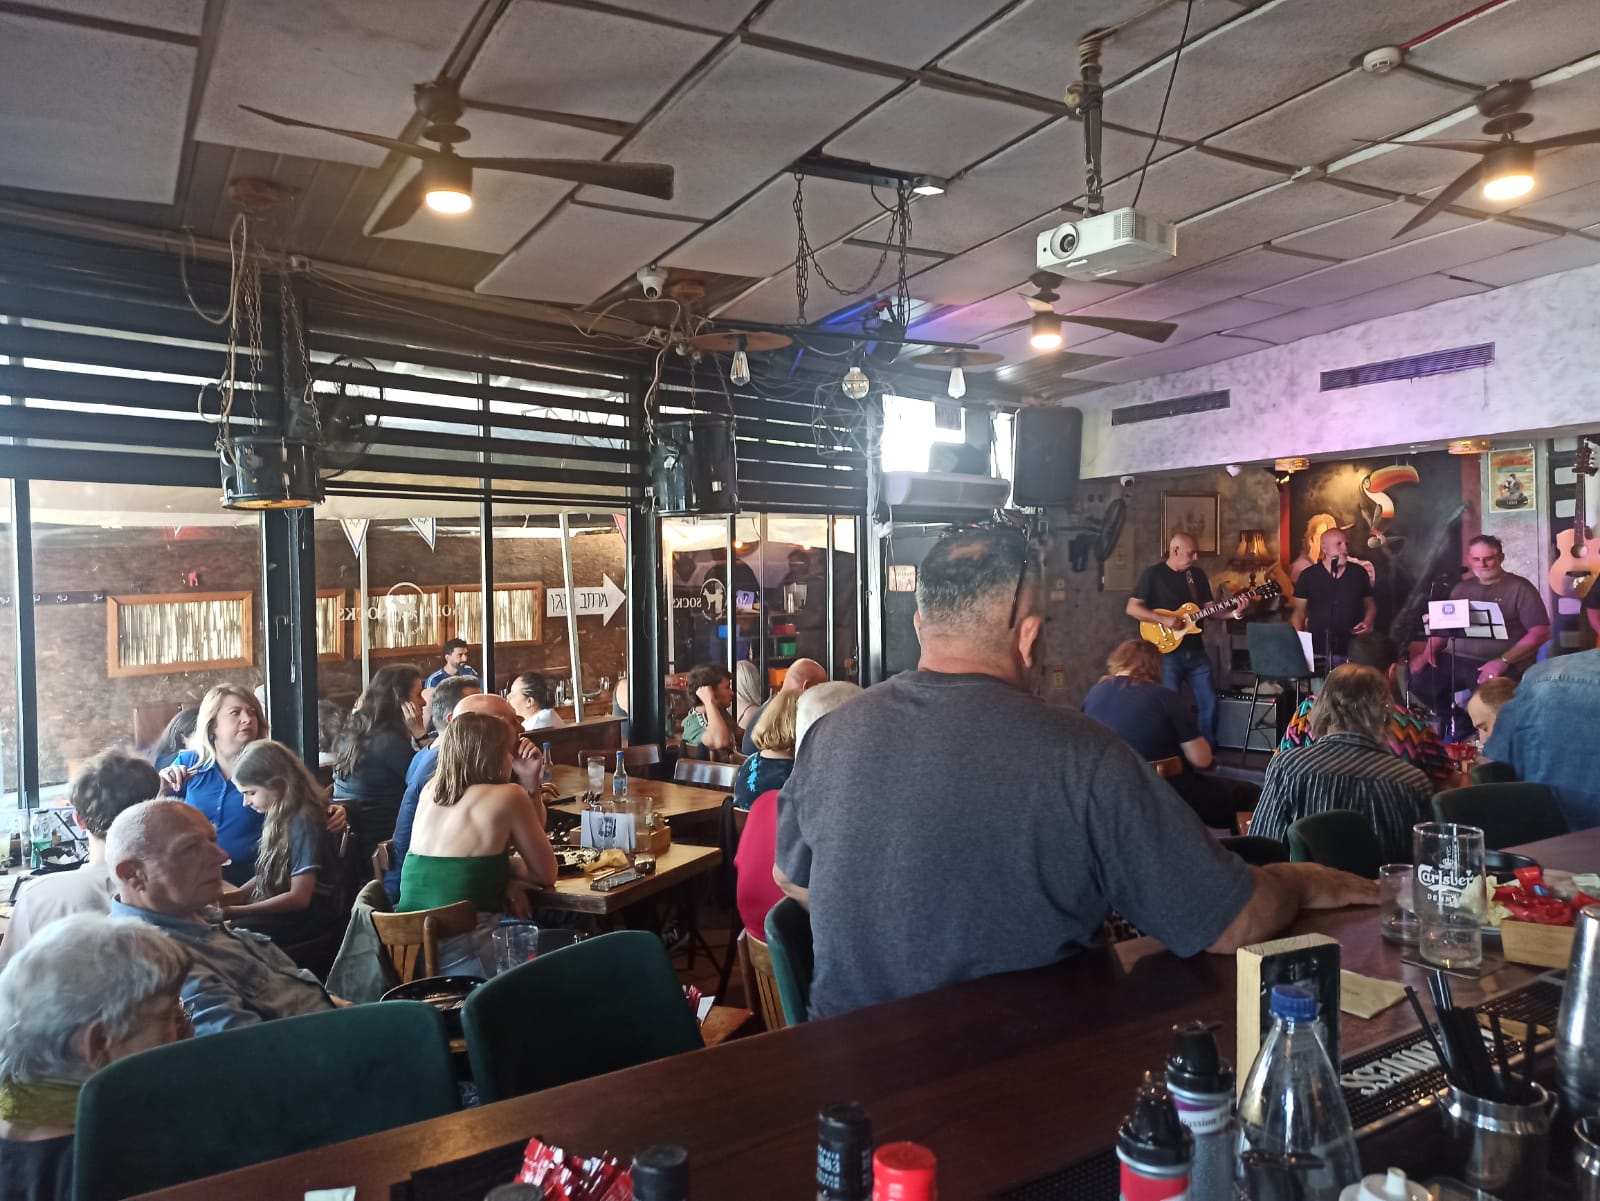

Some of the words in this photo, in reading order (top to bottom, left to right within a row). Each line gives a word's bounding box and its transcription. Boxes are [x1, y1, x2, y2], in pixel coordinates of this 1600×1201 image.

[550, 593, 568, 613] וגן
[579, 592, 609, 609] מרחב
[1417, 863, 1476, 887] Carlsber
